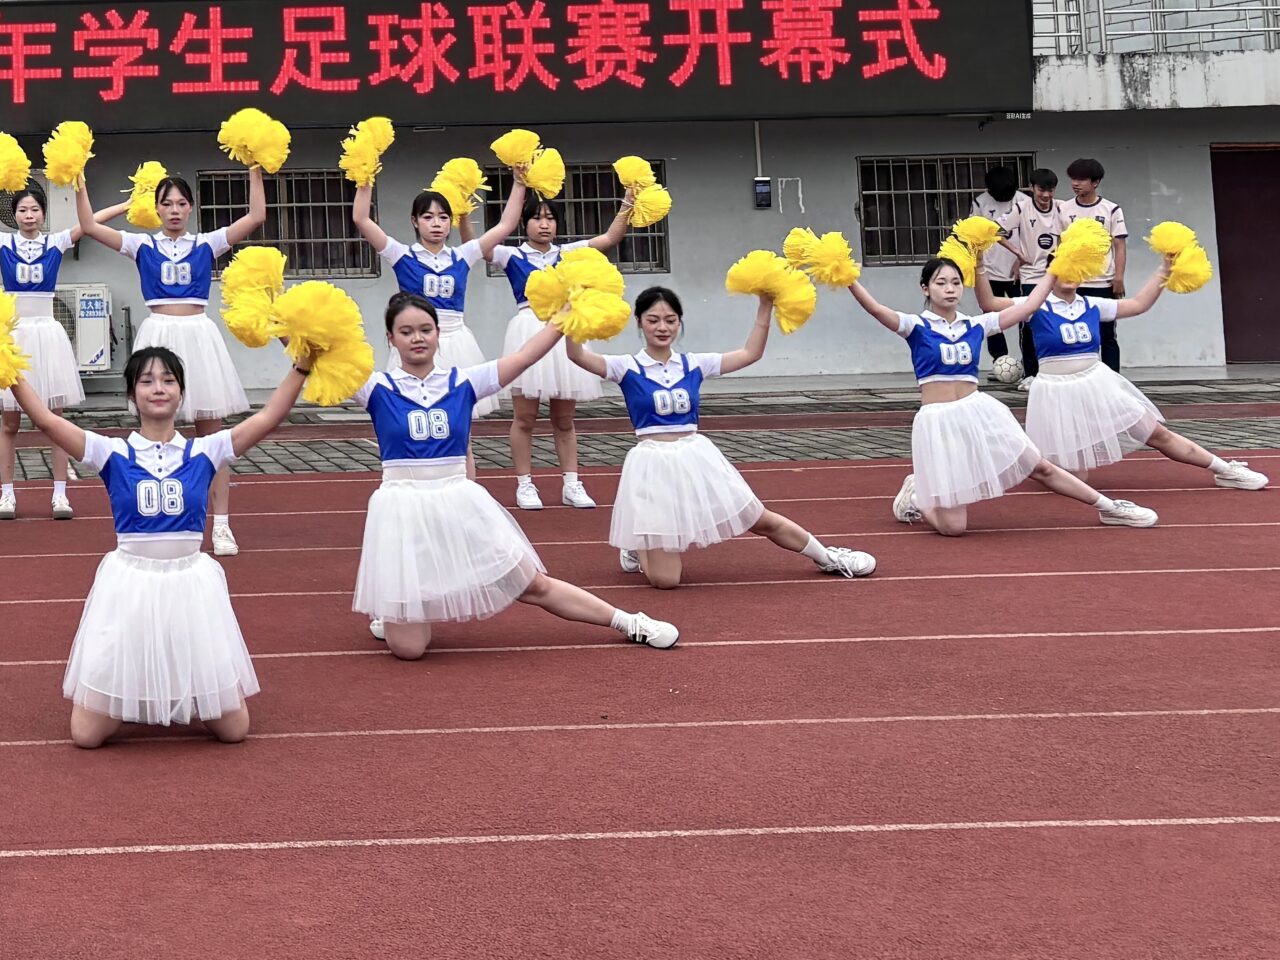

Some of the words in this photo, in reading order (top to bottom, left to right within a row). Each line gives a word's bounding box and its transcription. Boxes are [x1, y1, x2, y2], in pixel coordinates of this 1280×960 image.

[15, 262, 44, 284] 08
[160, 260, 193, 286] 08
[422, 273, 456, 298] 08
[1059, 322, 1092, 344] 08
[940, 341, 973, 366] 08
[653, 388, 691, 416] 08
[408, 409, 450, 441] 08
[136, 478, 185, 517] 08
